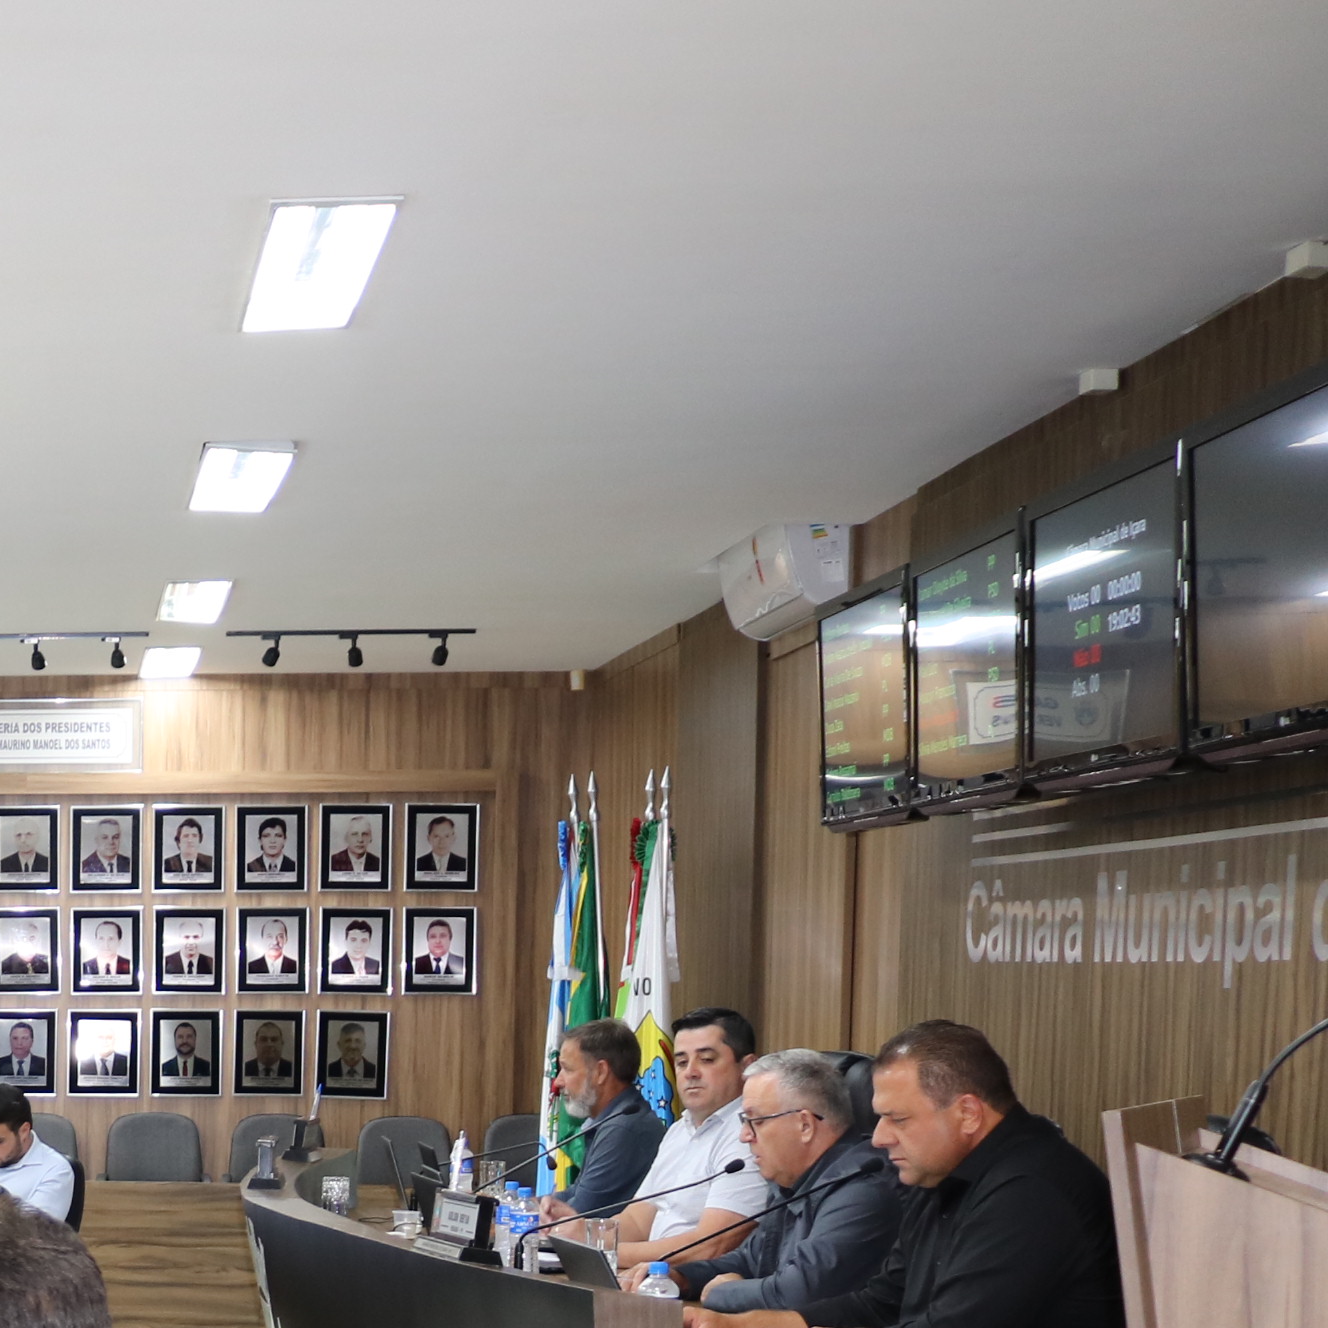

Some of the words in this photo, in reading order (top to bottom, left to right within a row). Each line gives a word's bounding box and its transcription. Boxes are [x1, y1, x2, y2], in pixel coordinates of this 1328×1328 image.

[1107, 604, 1141, 632] 19:02:43
[22, 722, 42, 733] DOS
[45, 721, 111, 733] PRESIDENTES
[32, 739, 62, 750] MANOEL
[64, 739, 80, 750] DOS
[81, 739, 111, 750] SANTOS
[966, 878, 1083, 964] Câmara
[1093, 853, 1298, 990] Municipal
